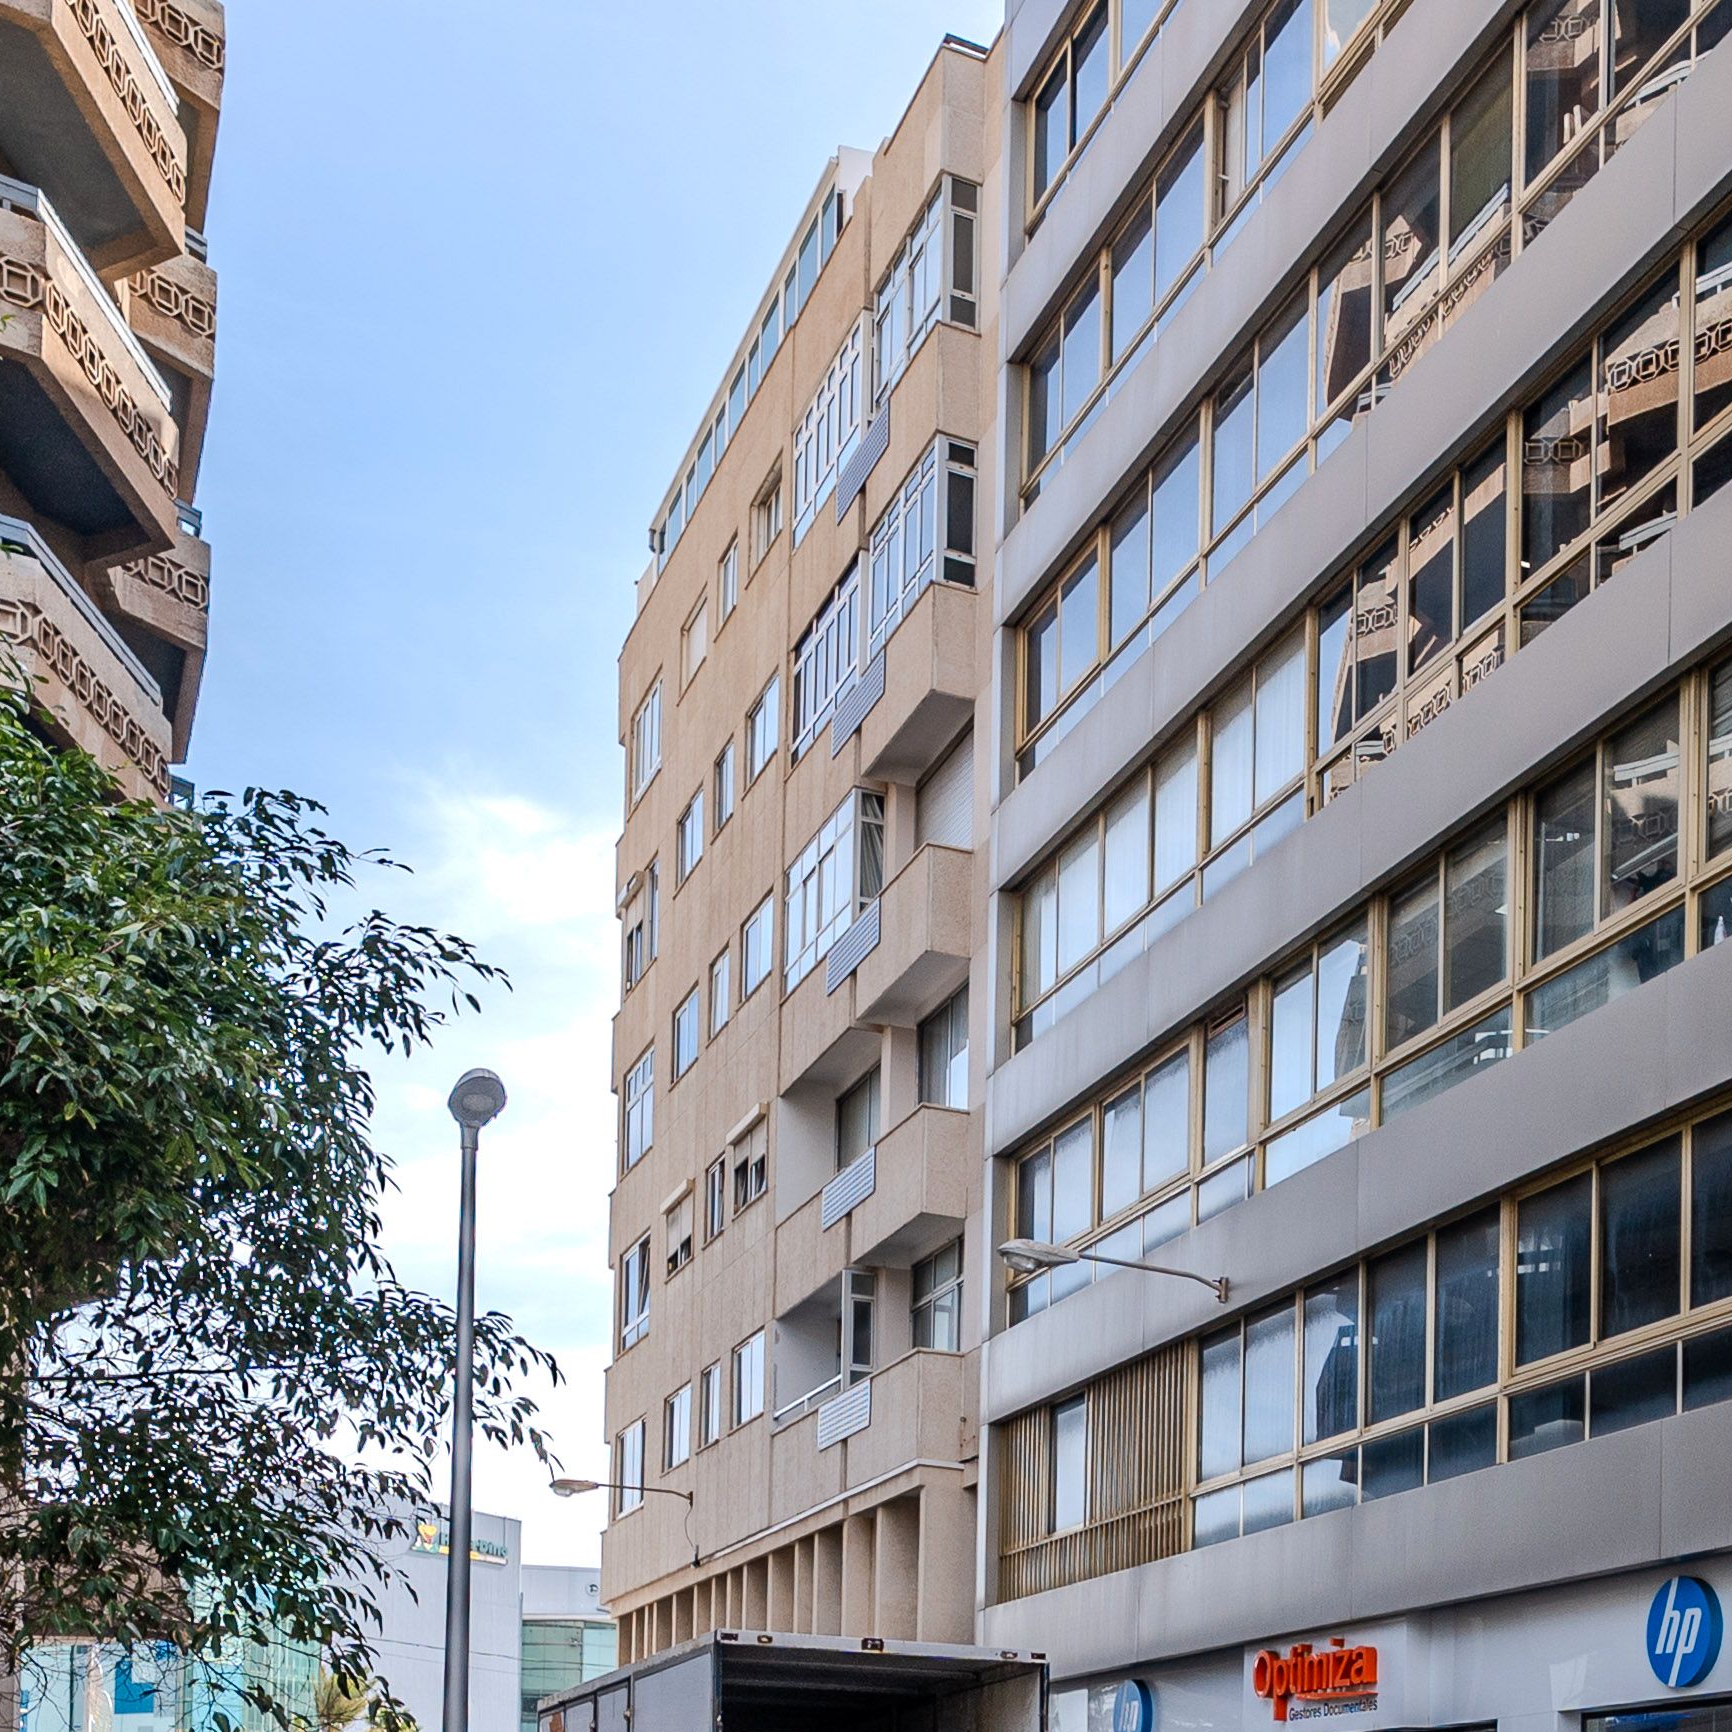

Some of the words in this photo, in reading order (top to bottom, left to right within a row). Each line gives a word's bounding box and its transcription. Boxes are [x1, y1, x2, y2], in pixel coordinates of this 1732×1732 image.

[1655, 1577, 1702, 1687] hp
[1253, 1637, 1378, 1721] Optimiza
[1289, 1703, 1322, 1722] Gestores
[1323, 1699, 1378, 1718] Documentales
